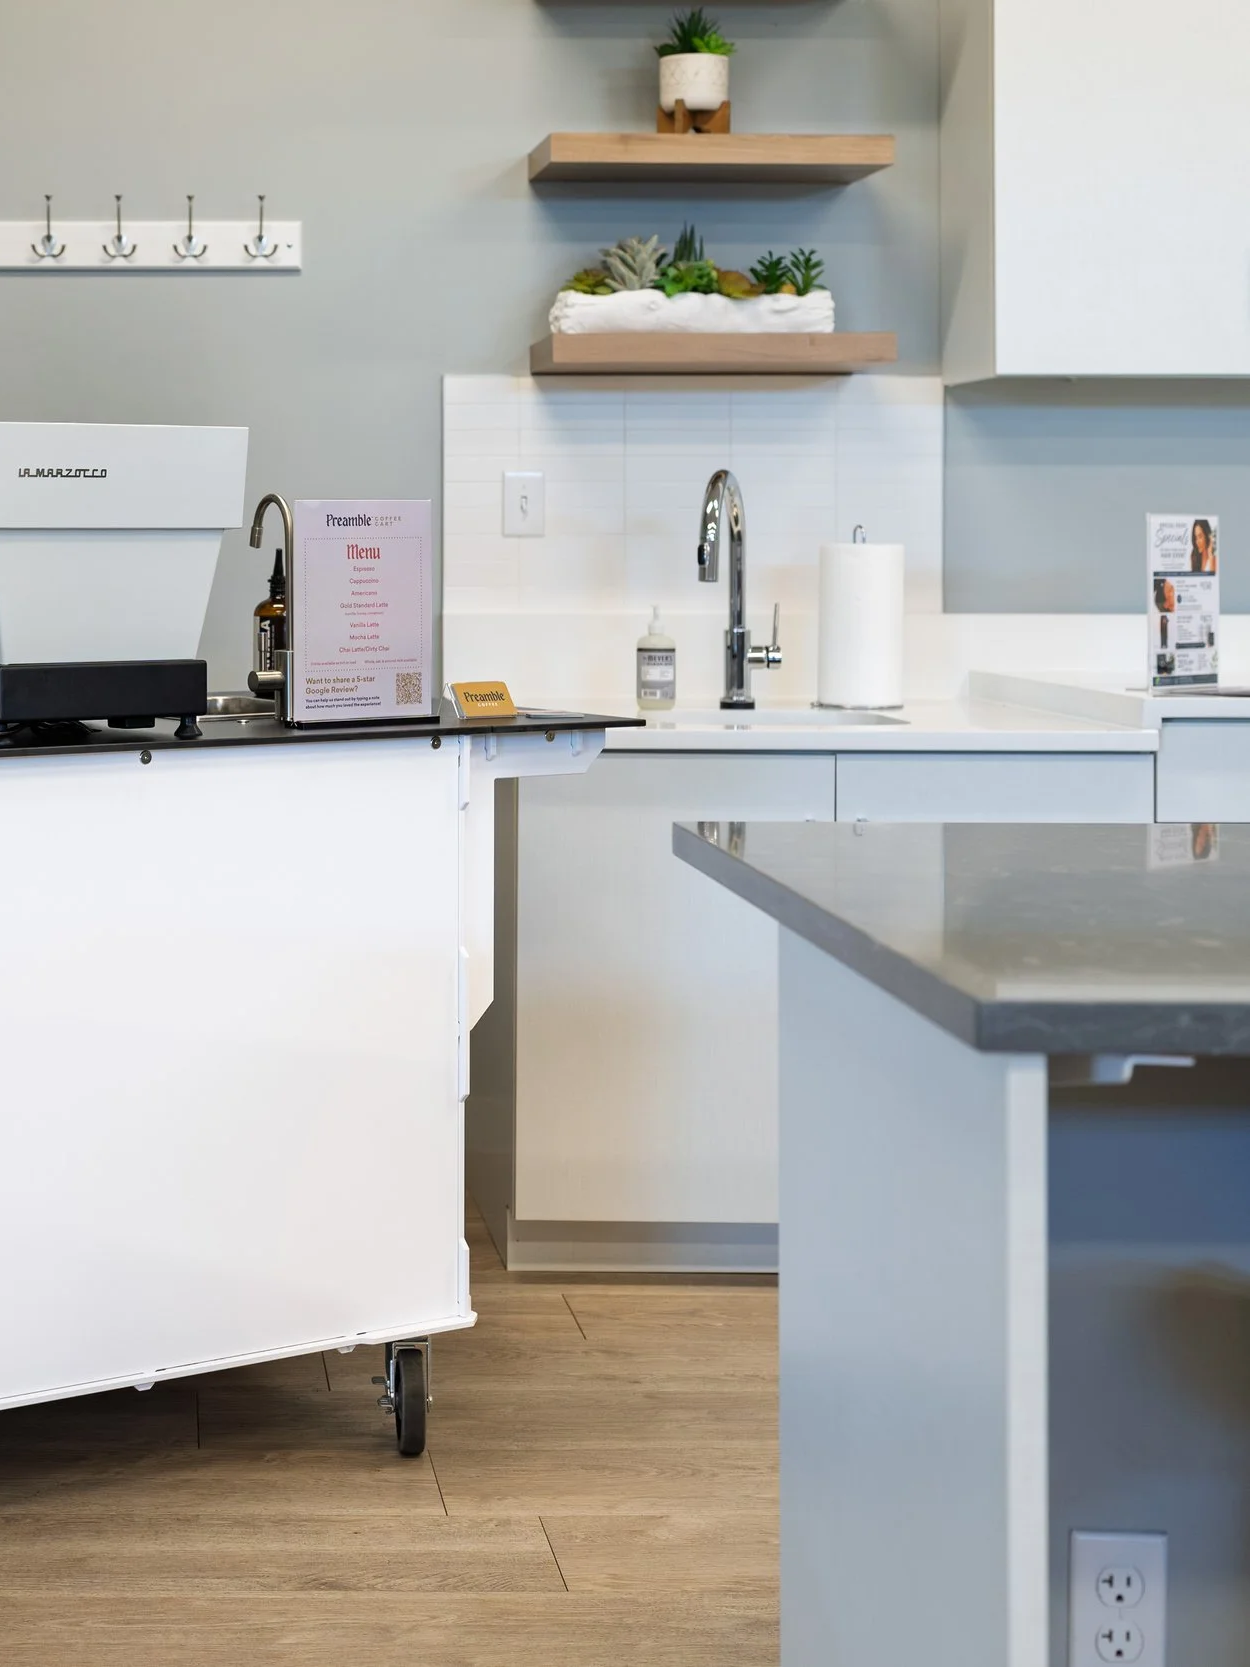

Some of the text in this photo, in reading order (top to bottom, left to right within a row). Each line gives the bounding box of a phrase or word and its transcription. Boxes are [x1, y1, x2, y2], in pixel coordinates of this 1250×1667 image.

[18, 468, 107, 478] LA MARZOCCO
[326, 513, 372, 527] Preamble
[346, 543, 381, 560] Menu
[353, 565, 376, 573] Espresso
[349, 577, 380, 585] Cappuccino
[305, 677, 324, 685] Want
[332, 676, 351, 684] share
[356, 675, 376, 683] 5-star
[305, 685, 359, 696] Google Review?
[463, 691, 506, 702] Preamble
